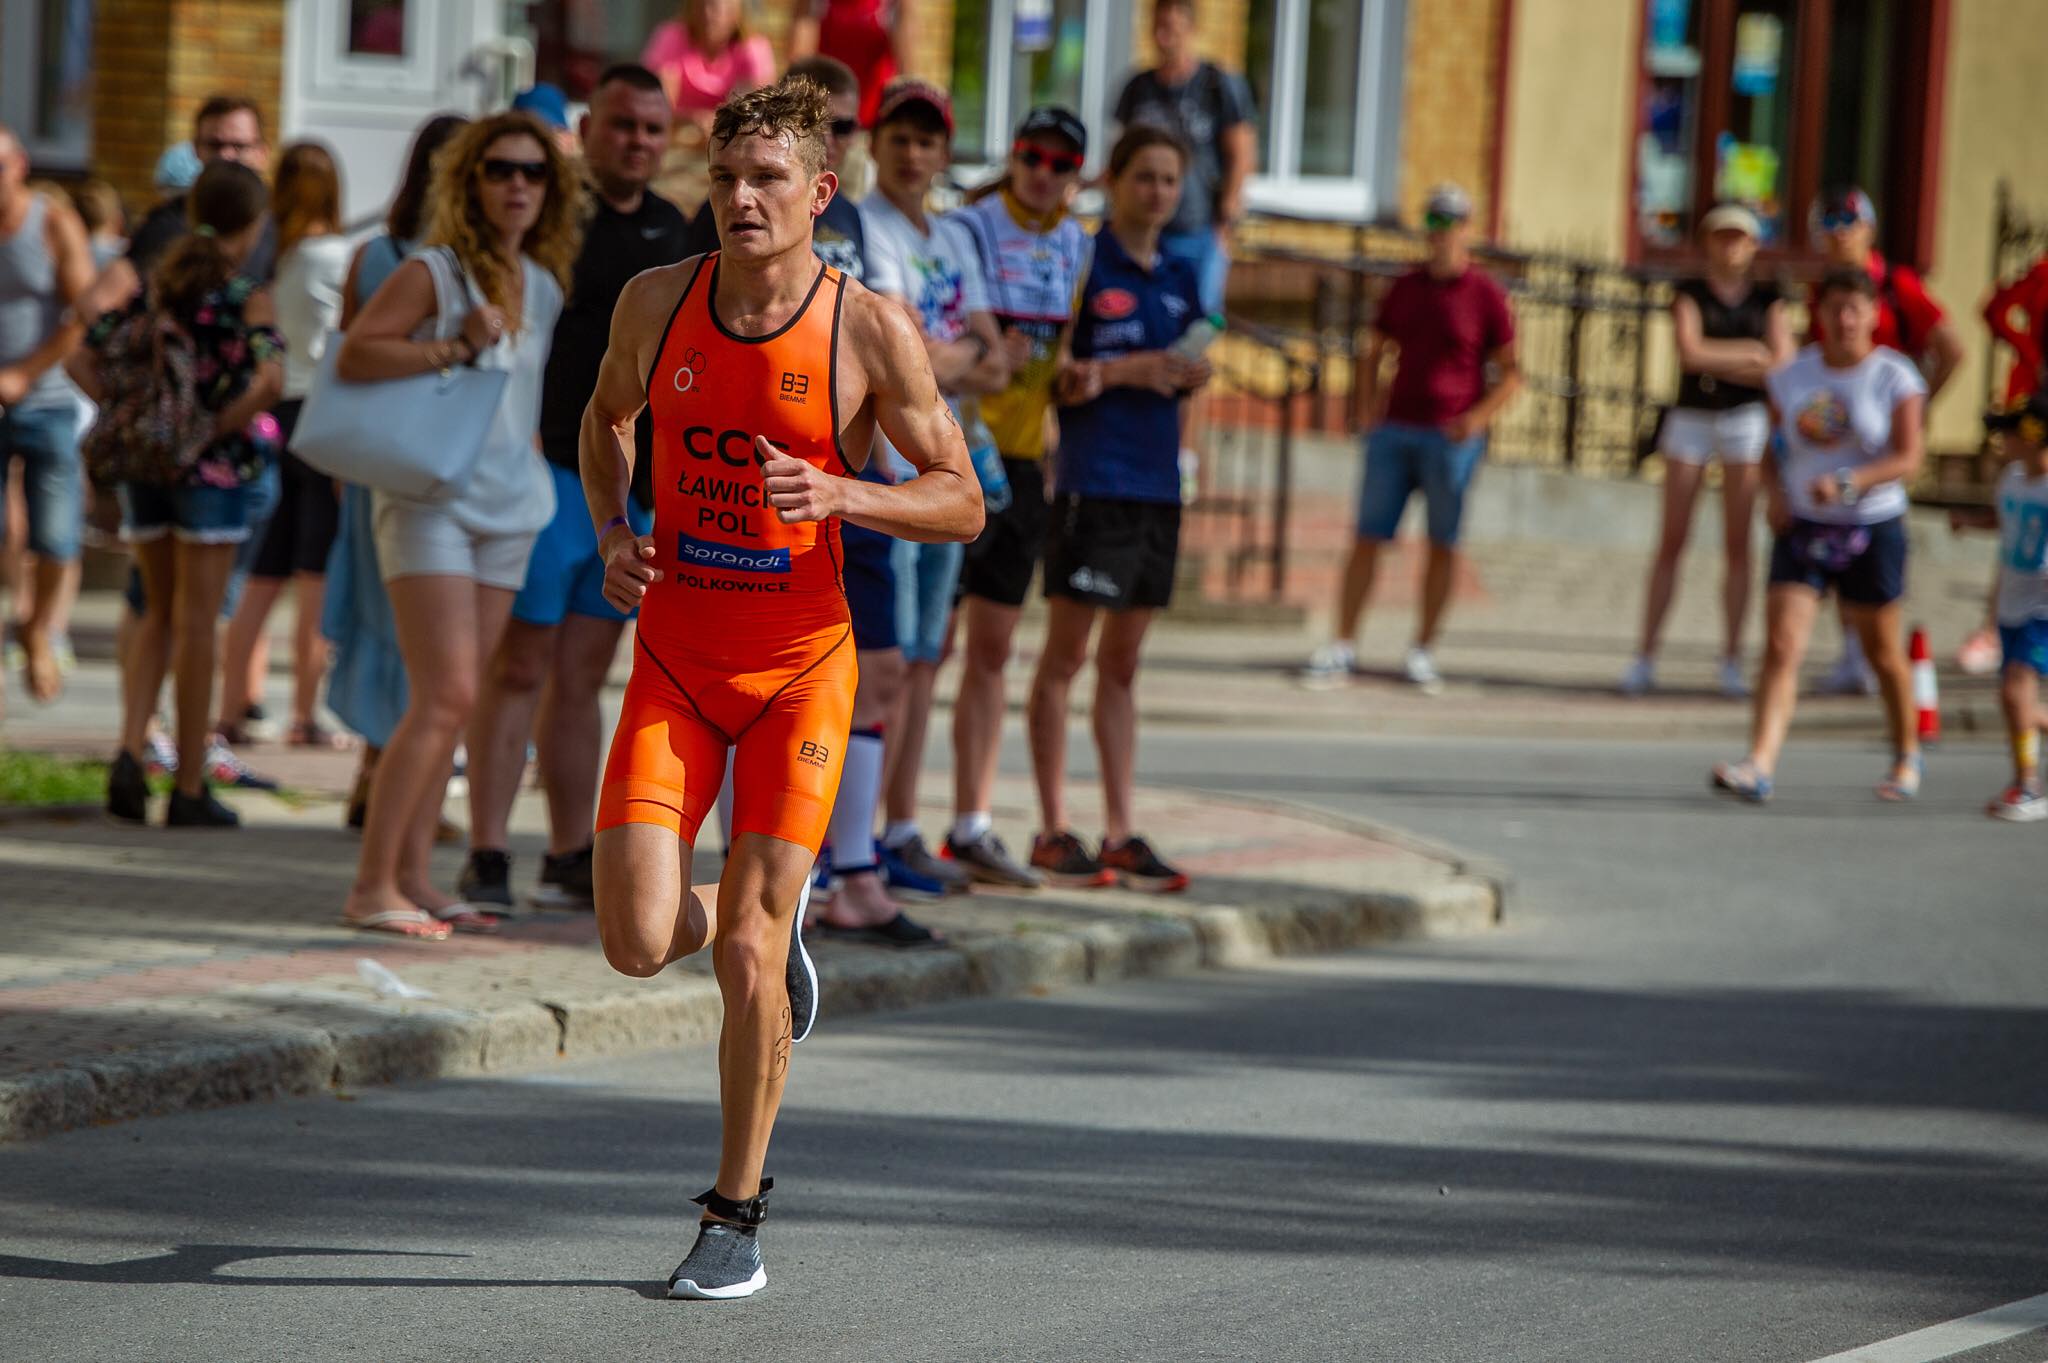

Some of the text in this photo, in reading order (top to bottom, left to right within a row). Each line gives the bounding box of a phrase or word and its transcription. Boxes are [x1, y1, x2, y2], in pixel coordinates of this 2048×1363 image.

[698, 507, 760, 538] POL
[683, 544, 781, 568] sprandi
[677, 573, 791, 592] POLKOWICE
